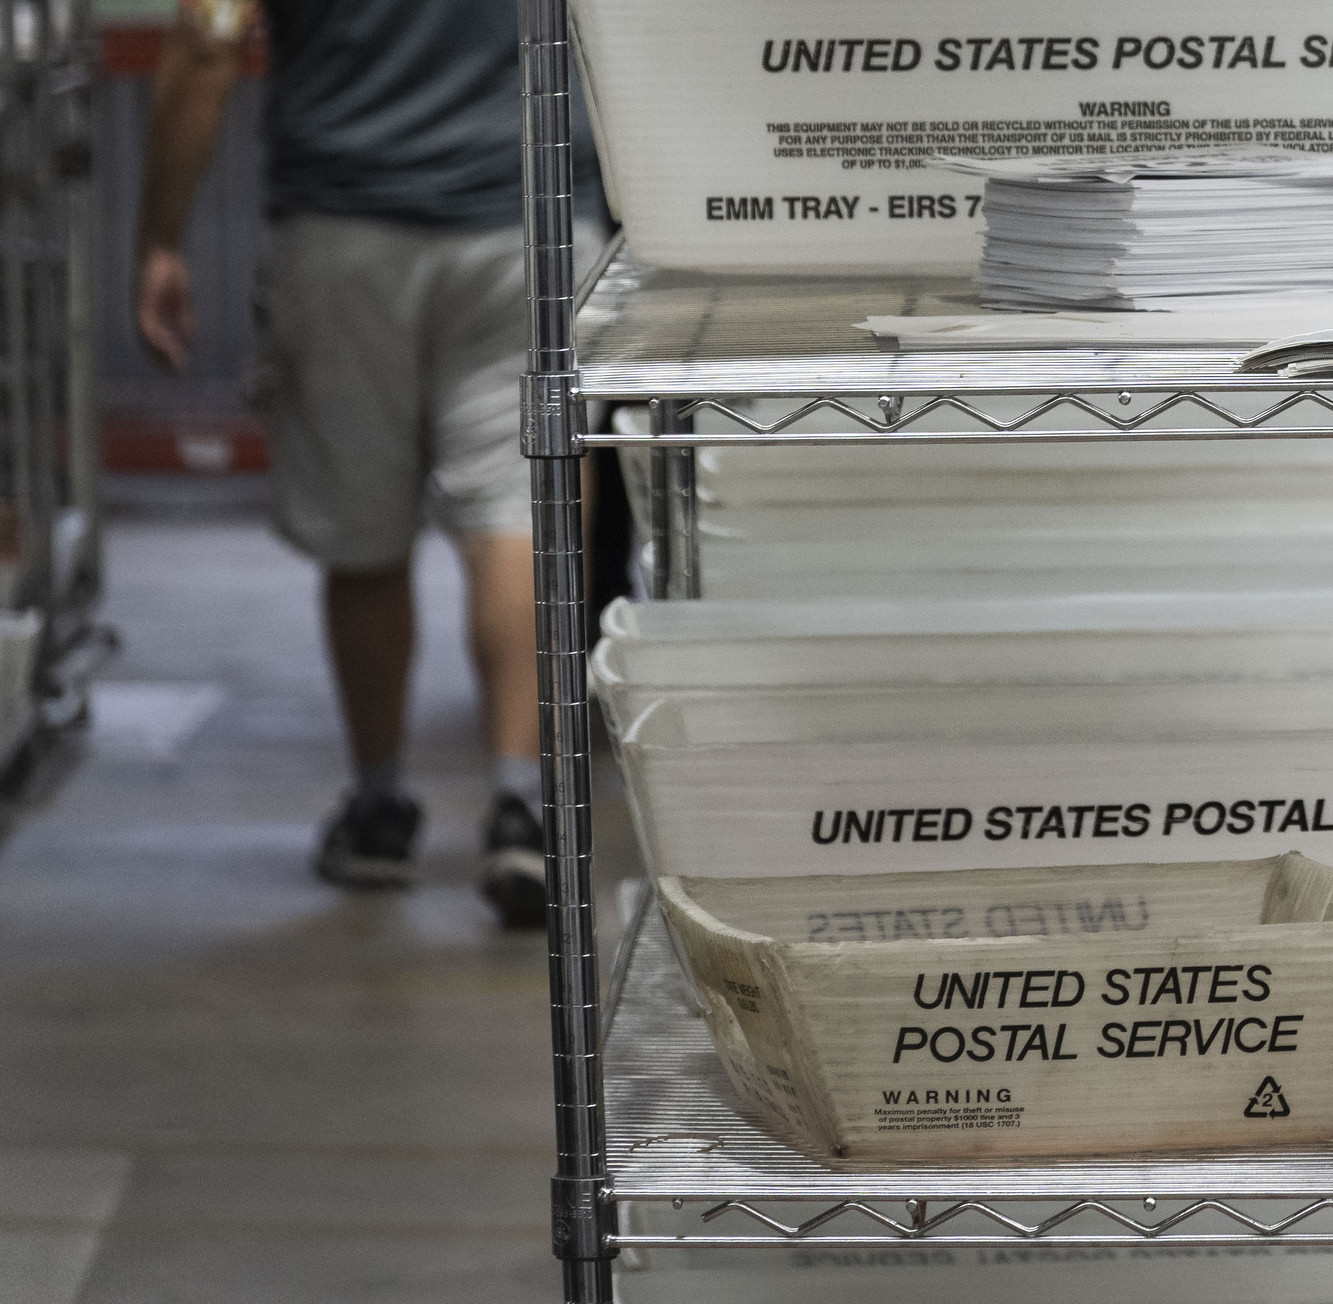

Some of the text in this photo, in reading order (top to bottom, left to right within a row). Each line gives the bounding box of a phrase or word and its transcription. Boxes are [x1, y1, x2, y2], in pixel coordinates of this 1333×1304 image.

[762, 38, 922, 73] UNITED
[934, 37, 1099, 72] STATES
[1111, 35, 1286, 70] POSTAL
[1078, 101, 1171, 117] WARNING
[766, 123, 790, 133] THIS
[793, 122, 857, 133] EQUIPMENT
[860, 122, 883, 132] MAY
[886, 122, 909, 132] NOT
[911, 122, 926, 132] BE
[929, 121, 960, 131] SOLD
[962, 121, 979, 131] OR
[982, 120, 1041, 131] RECYCLED
[1044, 120, 1093, 131] WITHOUT
[1096, 120, 1118, 130] THE
[1121, 120, 1189, 130] PERMISSION
[1193, 120, 1209, 130] OF
[1210, 119, 1232, 130] THE
[1234, 119, 1250, 129] US
[1253, 119, 1296, 129] POSTAL
[779, 135, 802, 145] FOR
[804, 135, 827, 145] ANY
[830, 134, 883, 144] PURPOSE
[886, 134, 923, 144] OTHER
[926, 134, 954, 144] THAN
[955, 133, 978, 143] THE
[981, 133, 1047, 143] TRANSPORT
[1051, 133, 1066, 142] OF
[1069, 133, 1084, 142] US
[1087, 133, 1113, 142] MAIL
[1116, 132, 1127, 142] IS
[1130, 132, 1181, 142] STRICTLY
[1184, 132, 1252, 142] PROHIBITED
[1255, 132, 1271, 141] BY
[1274, 131, 1325, 141] FEDERAL
[774, 148, 803, 157] USES
[806, 147, 876, 157] ELECTRONIC
[878, 146, 934, 156] TRACKING
[937, 145, 1012, 156] TECHNOLOGY
[1016, 145, 1029, 155] TO
[1031, 145, 1083, 155] MONITOR
[1086, 145, 1107, 155] THE
[1109, 144, 1165, 154] LOCATION
[841, 160, 857, 169] OF
[860, 160, 875, 169] UP
[877, 160, 891, 169] TO
[705, 196, 773, 221] EMM
[782, 195, 860, 221] TRAY
[887, 194, 957, 220] EIRS
[812, 808, 972, 844] UNITED
[983, 804, 1150, 840] STATES
[913, 964, 1273, 1010] UNITED STATES
[893, 1015, 1304, 1064] POSTAL SERVICE
[882, 1088, 1011, 1105] WARNING
[1262, 1092, 1274, 1109] 2
[874, 1108, 915, 1116] Maximum
[916, 1108, 948, 1116] penalty
[889, 1116, 915, 1124] postal
[916, 1115, 952, 1124] property
[878, 1124, 901, 1132] years
[902, 1123, 960, 1131] imprisonment
[996, 1120, 1021, 1128] 1707.)
